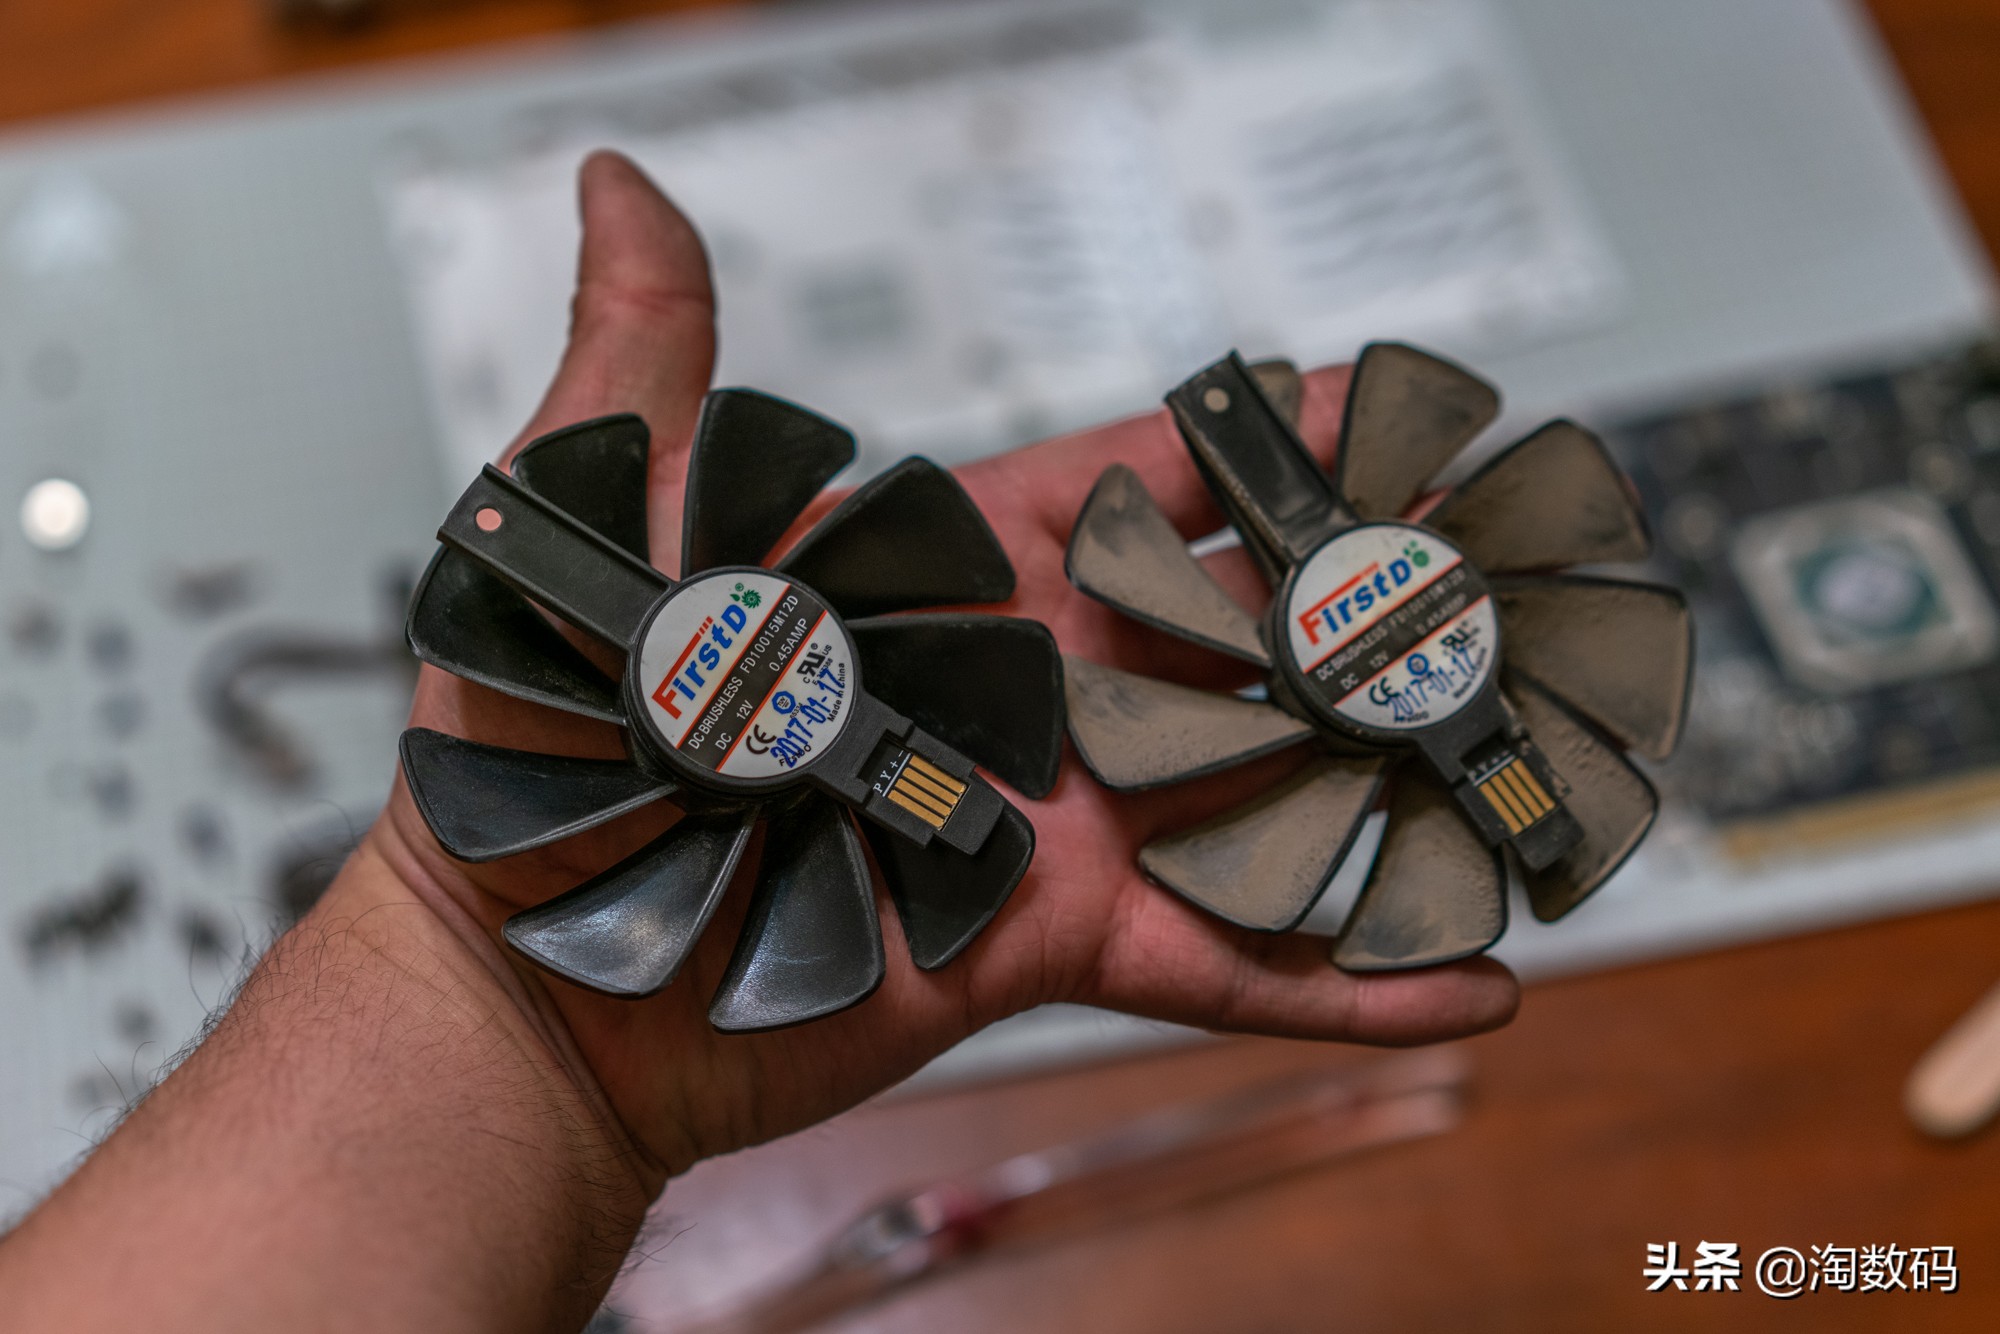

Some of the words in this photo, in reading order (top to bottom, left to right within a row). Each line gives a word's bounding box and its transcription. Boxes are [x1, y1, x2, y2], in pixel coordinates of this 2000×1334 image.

[1298, 558, 1412, 646] FirstD
[652, 604, 748, 720] FirstD
[688, 732, 705, 750] DC
[700, 676, 743, 735] BRUSHLESS
[740, 594, 799, 674] FD10015M12D
[715, 732, 732, 750] DC
[736, 700, 754, 720] 12V
[768, 618, 809, 672] 0.45AMP
[1316, 663, 1334, 681] DC
[1331, 623, 1388, 670] BRUSHLESS
[1340, 672, 1359, 691] DC
[746, 724, 777, 754] CE
[770, 668, 843, 768] 2017-01-17
[827, 699, 841, 722] Made
